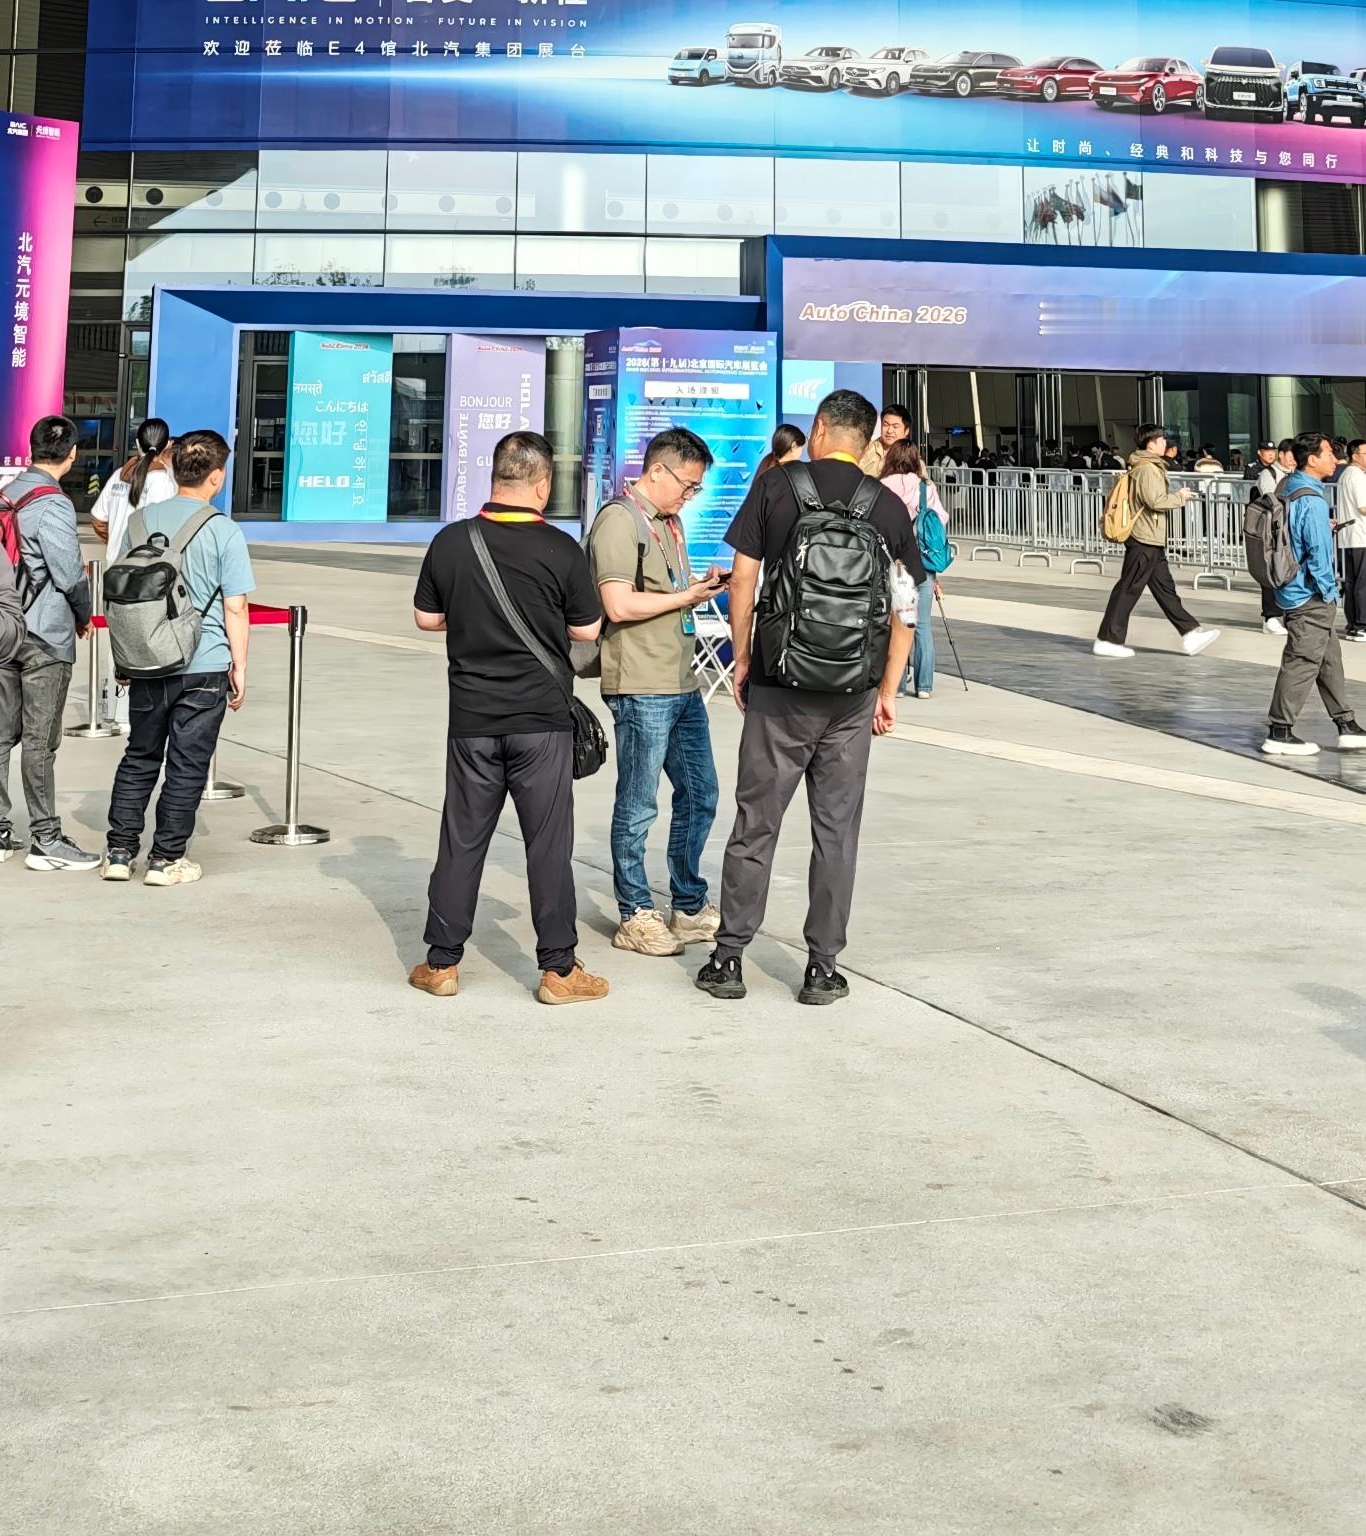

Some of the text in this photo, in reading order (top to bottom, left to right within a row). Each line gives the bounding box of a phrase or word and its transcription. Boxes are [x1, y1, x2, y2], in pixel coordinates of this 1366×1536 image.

[205, 16, 588, 28] INTELLIGENCE IN MOTION FUTURE IN VISION
[202, 40, 587, 60] 欢迎莅临E4馆北汽集团展台
[1026, 138, 1339, 169] 让时尚、经典和科技与您同行
[12, 231, 34, 368] 北汽元境智能
[800, 301, 968, 324] Auto China 2026
[315, 400, 368, 413] こんにちは
[460, 396, 513, 408] BONJOUR
[477, 412, 512, 430] 您好
